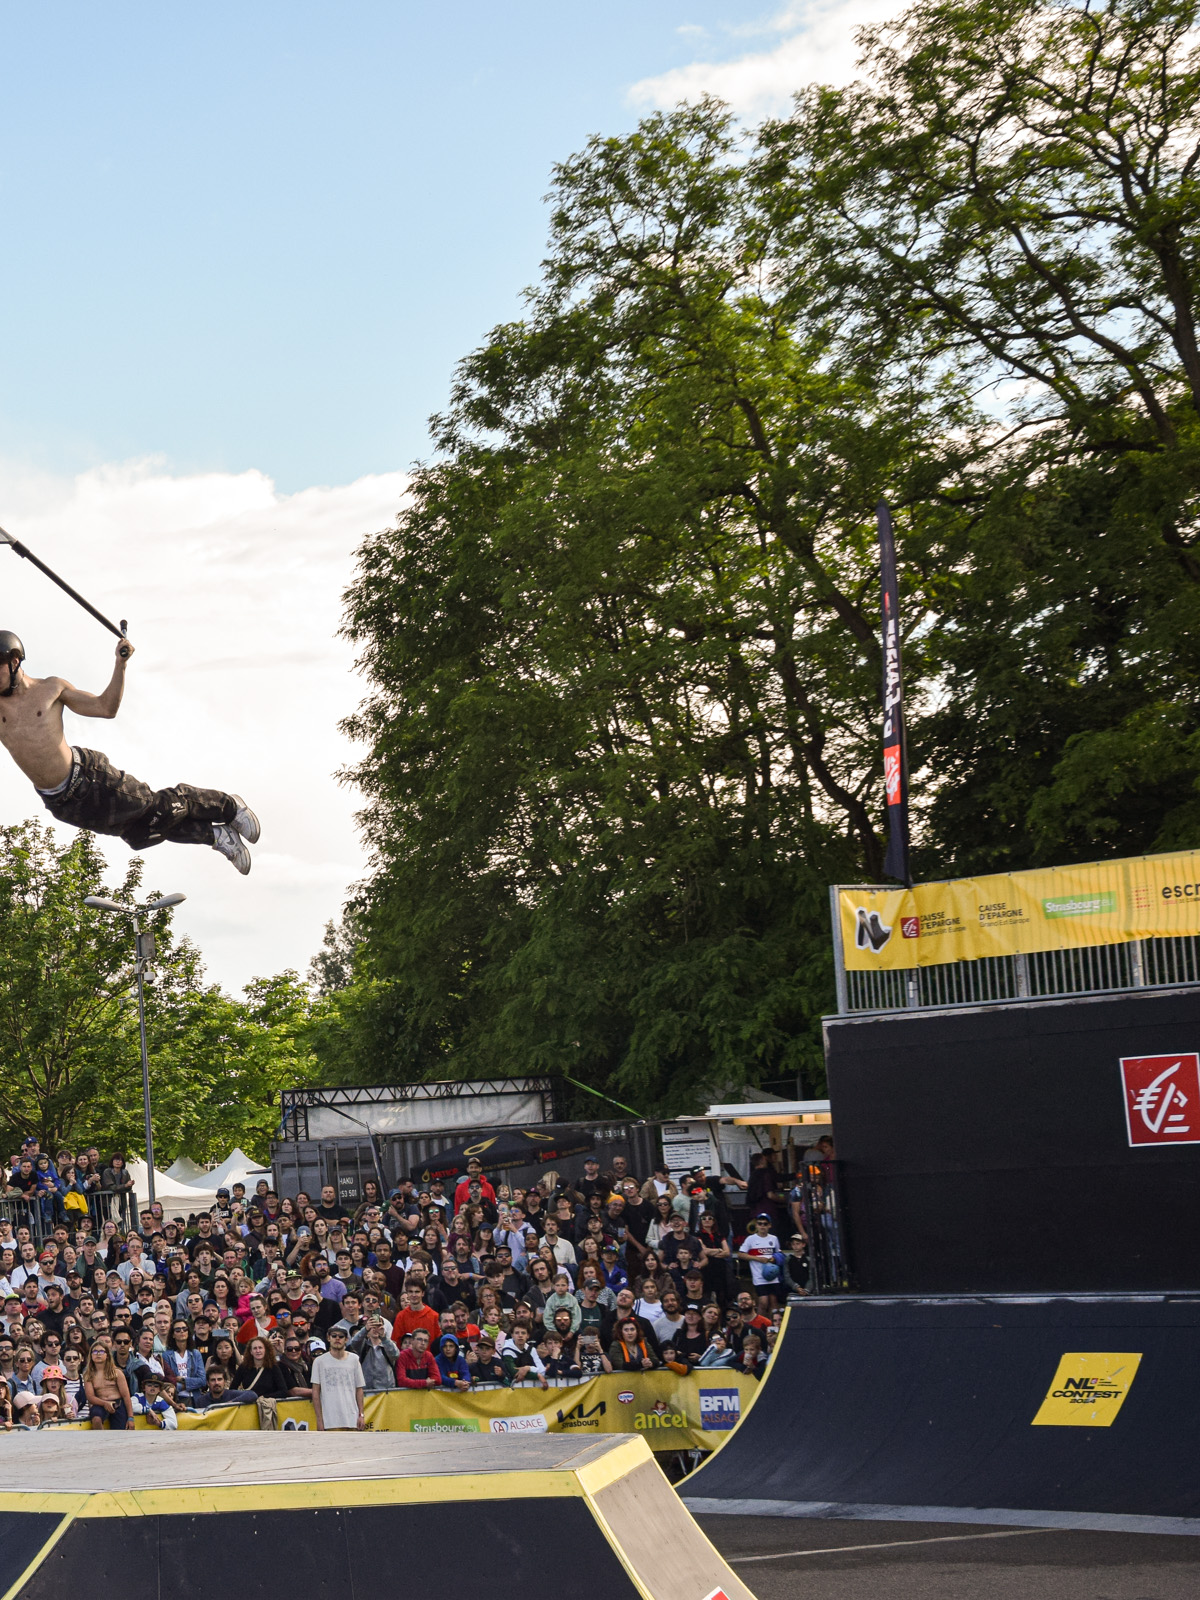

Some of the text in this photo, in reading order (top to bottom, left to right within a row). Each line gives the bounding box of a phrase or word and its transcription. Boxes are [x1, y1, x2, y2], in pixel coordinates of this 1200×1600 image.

[979, 902, 1006, 913] CAISSE
[979, 909, 1023, 920] D'EPARGNE
[1063, 1377, 1095, 1389] NL
[1052, 1390, 1123, 1399] CONTEST
[699, 1395, 740, 1412] BFM
[556, 1401, 606, 1423] KIA
[702, 1412, 740, 1424] ALSACE
[510, 1418, 544, 1430] ALSACE
[634, 1409, 689, 1430] ancel
